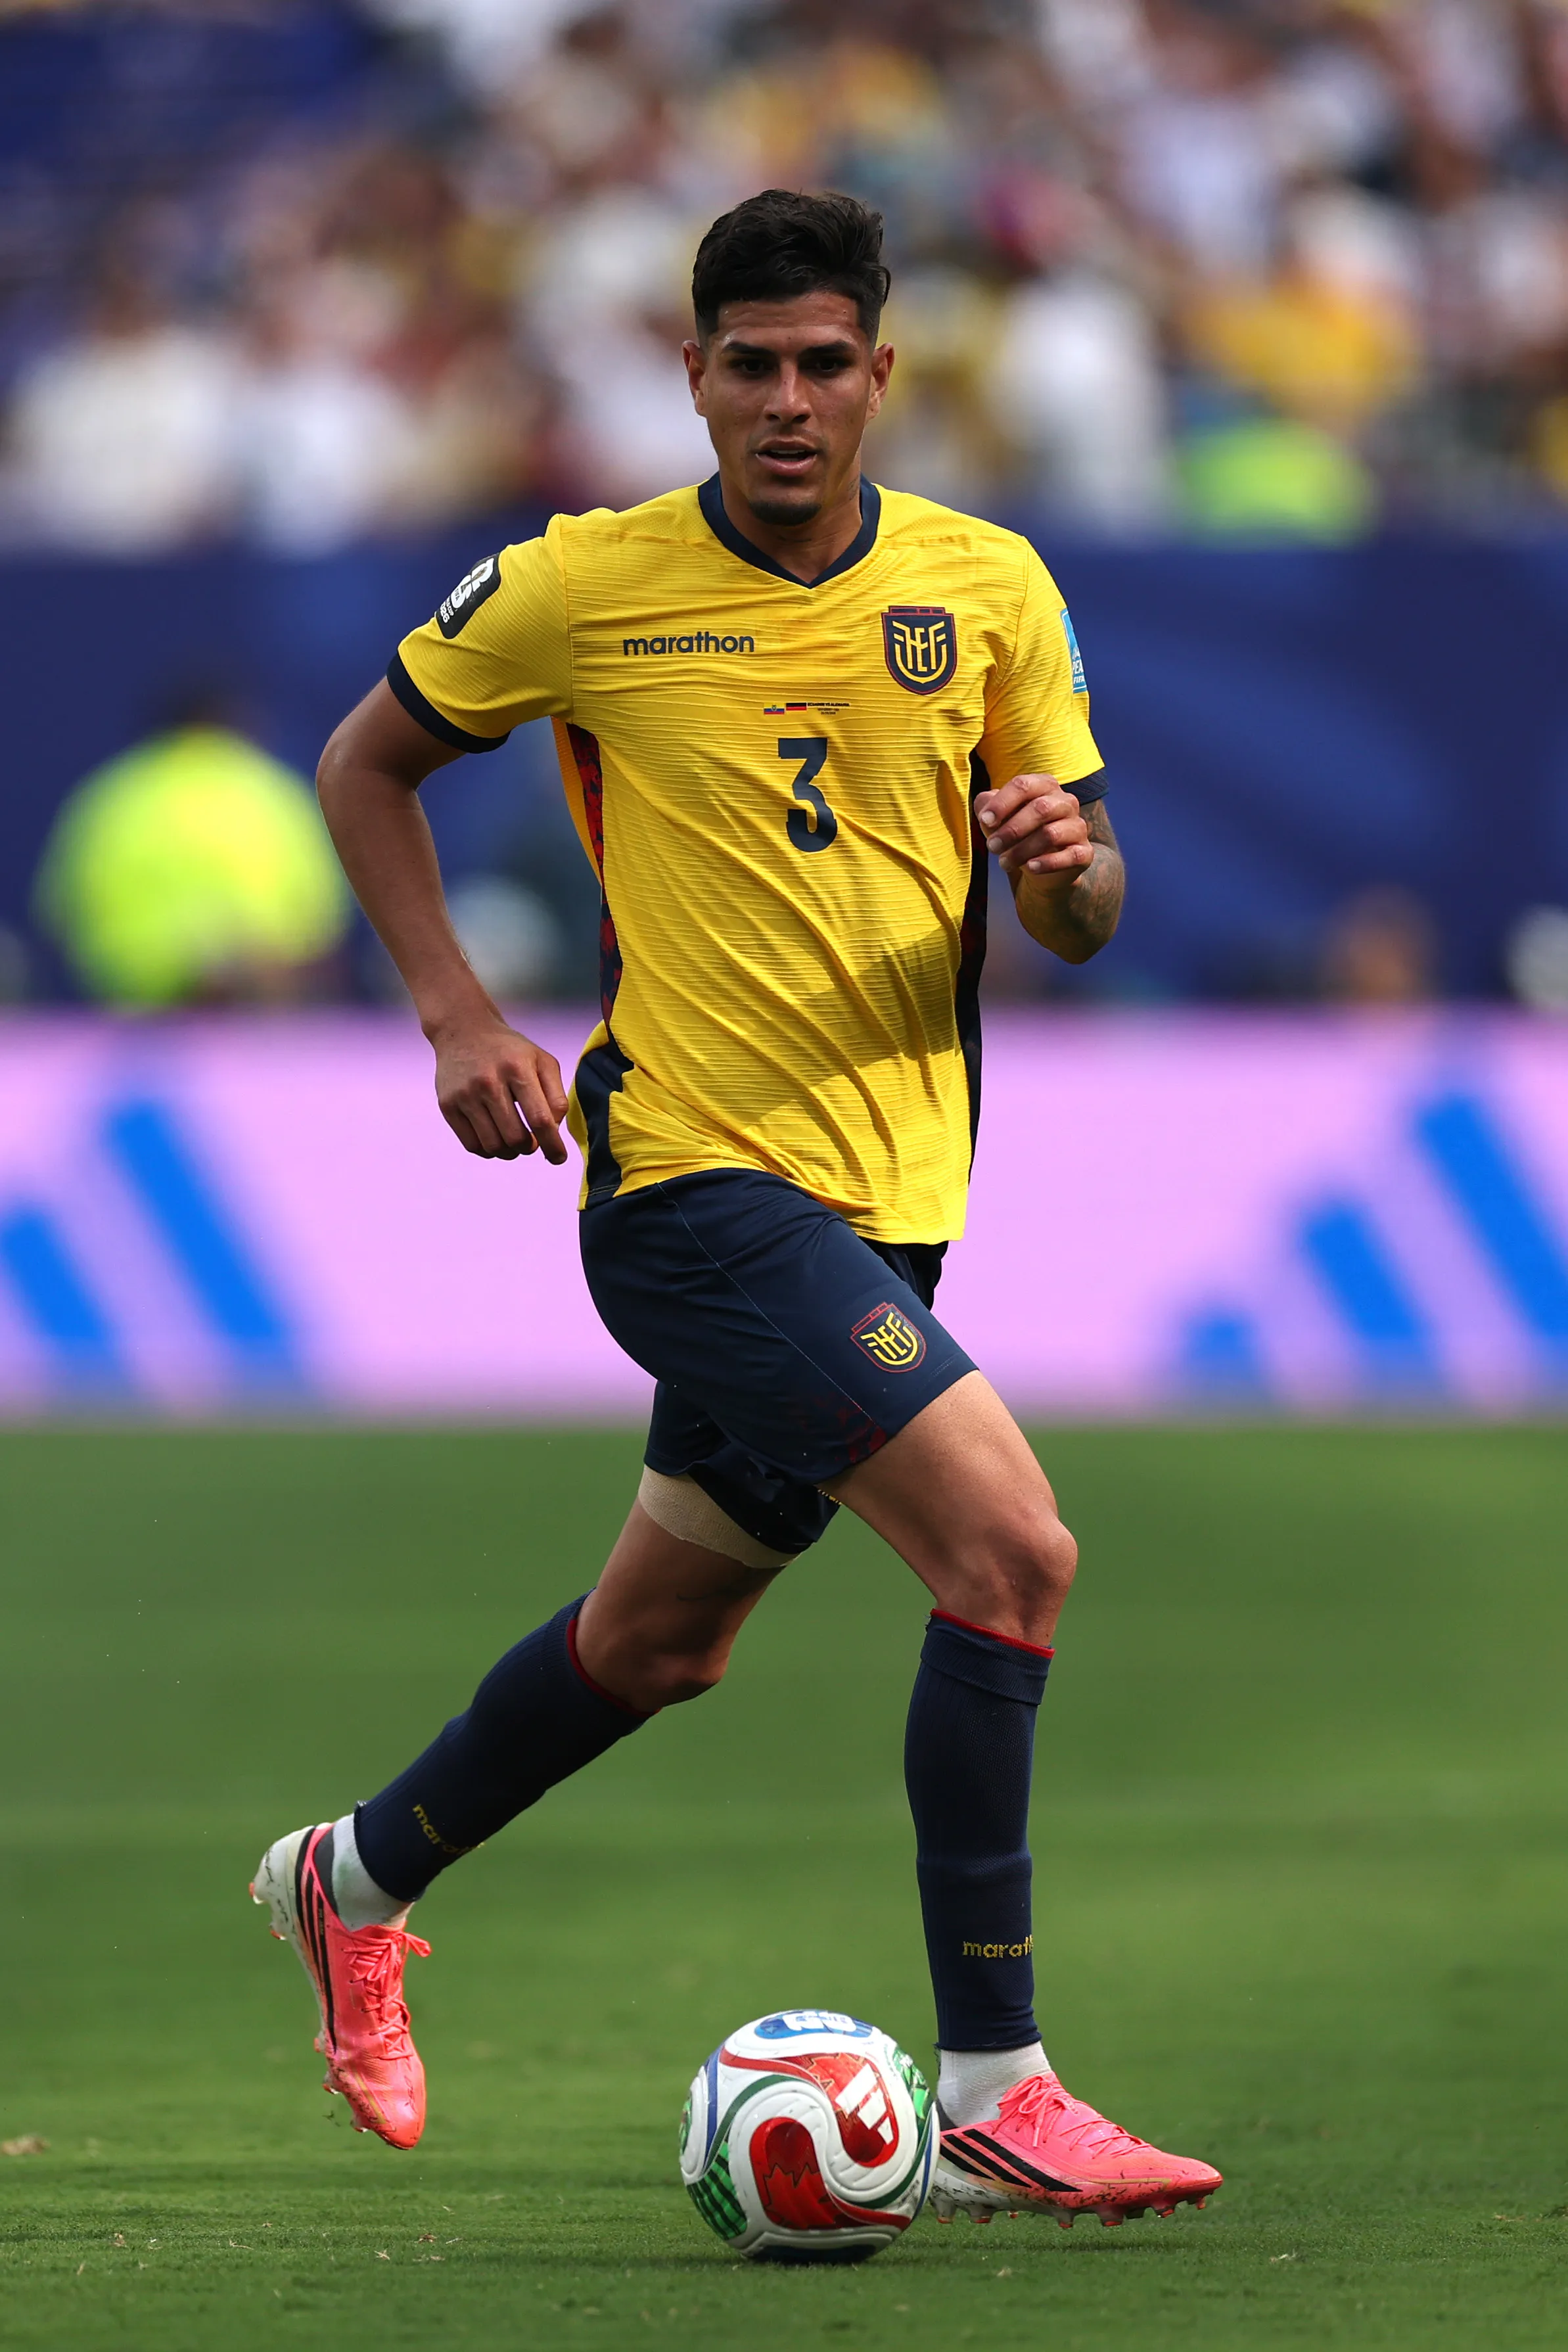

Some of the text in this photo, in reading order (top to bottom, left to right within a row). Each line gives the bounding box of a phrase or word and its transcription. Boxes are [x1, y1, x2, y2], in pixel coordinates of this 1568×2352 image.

[440, 601, 450, 623] 026
[623, 631, 754, 655] marathon
[1073, 676, 1085, 684] FIFA
[778, 737, 838, 852] 3
